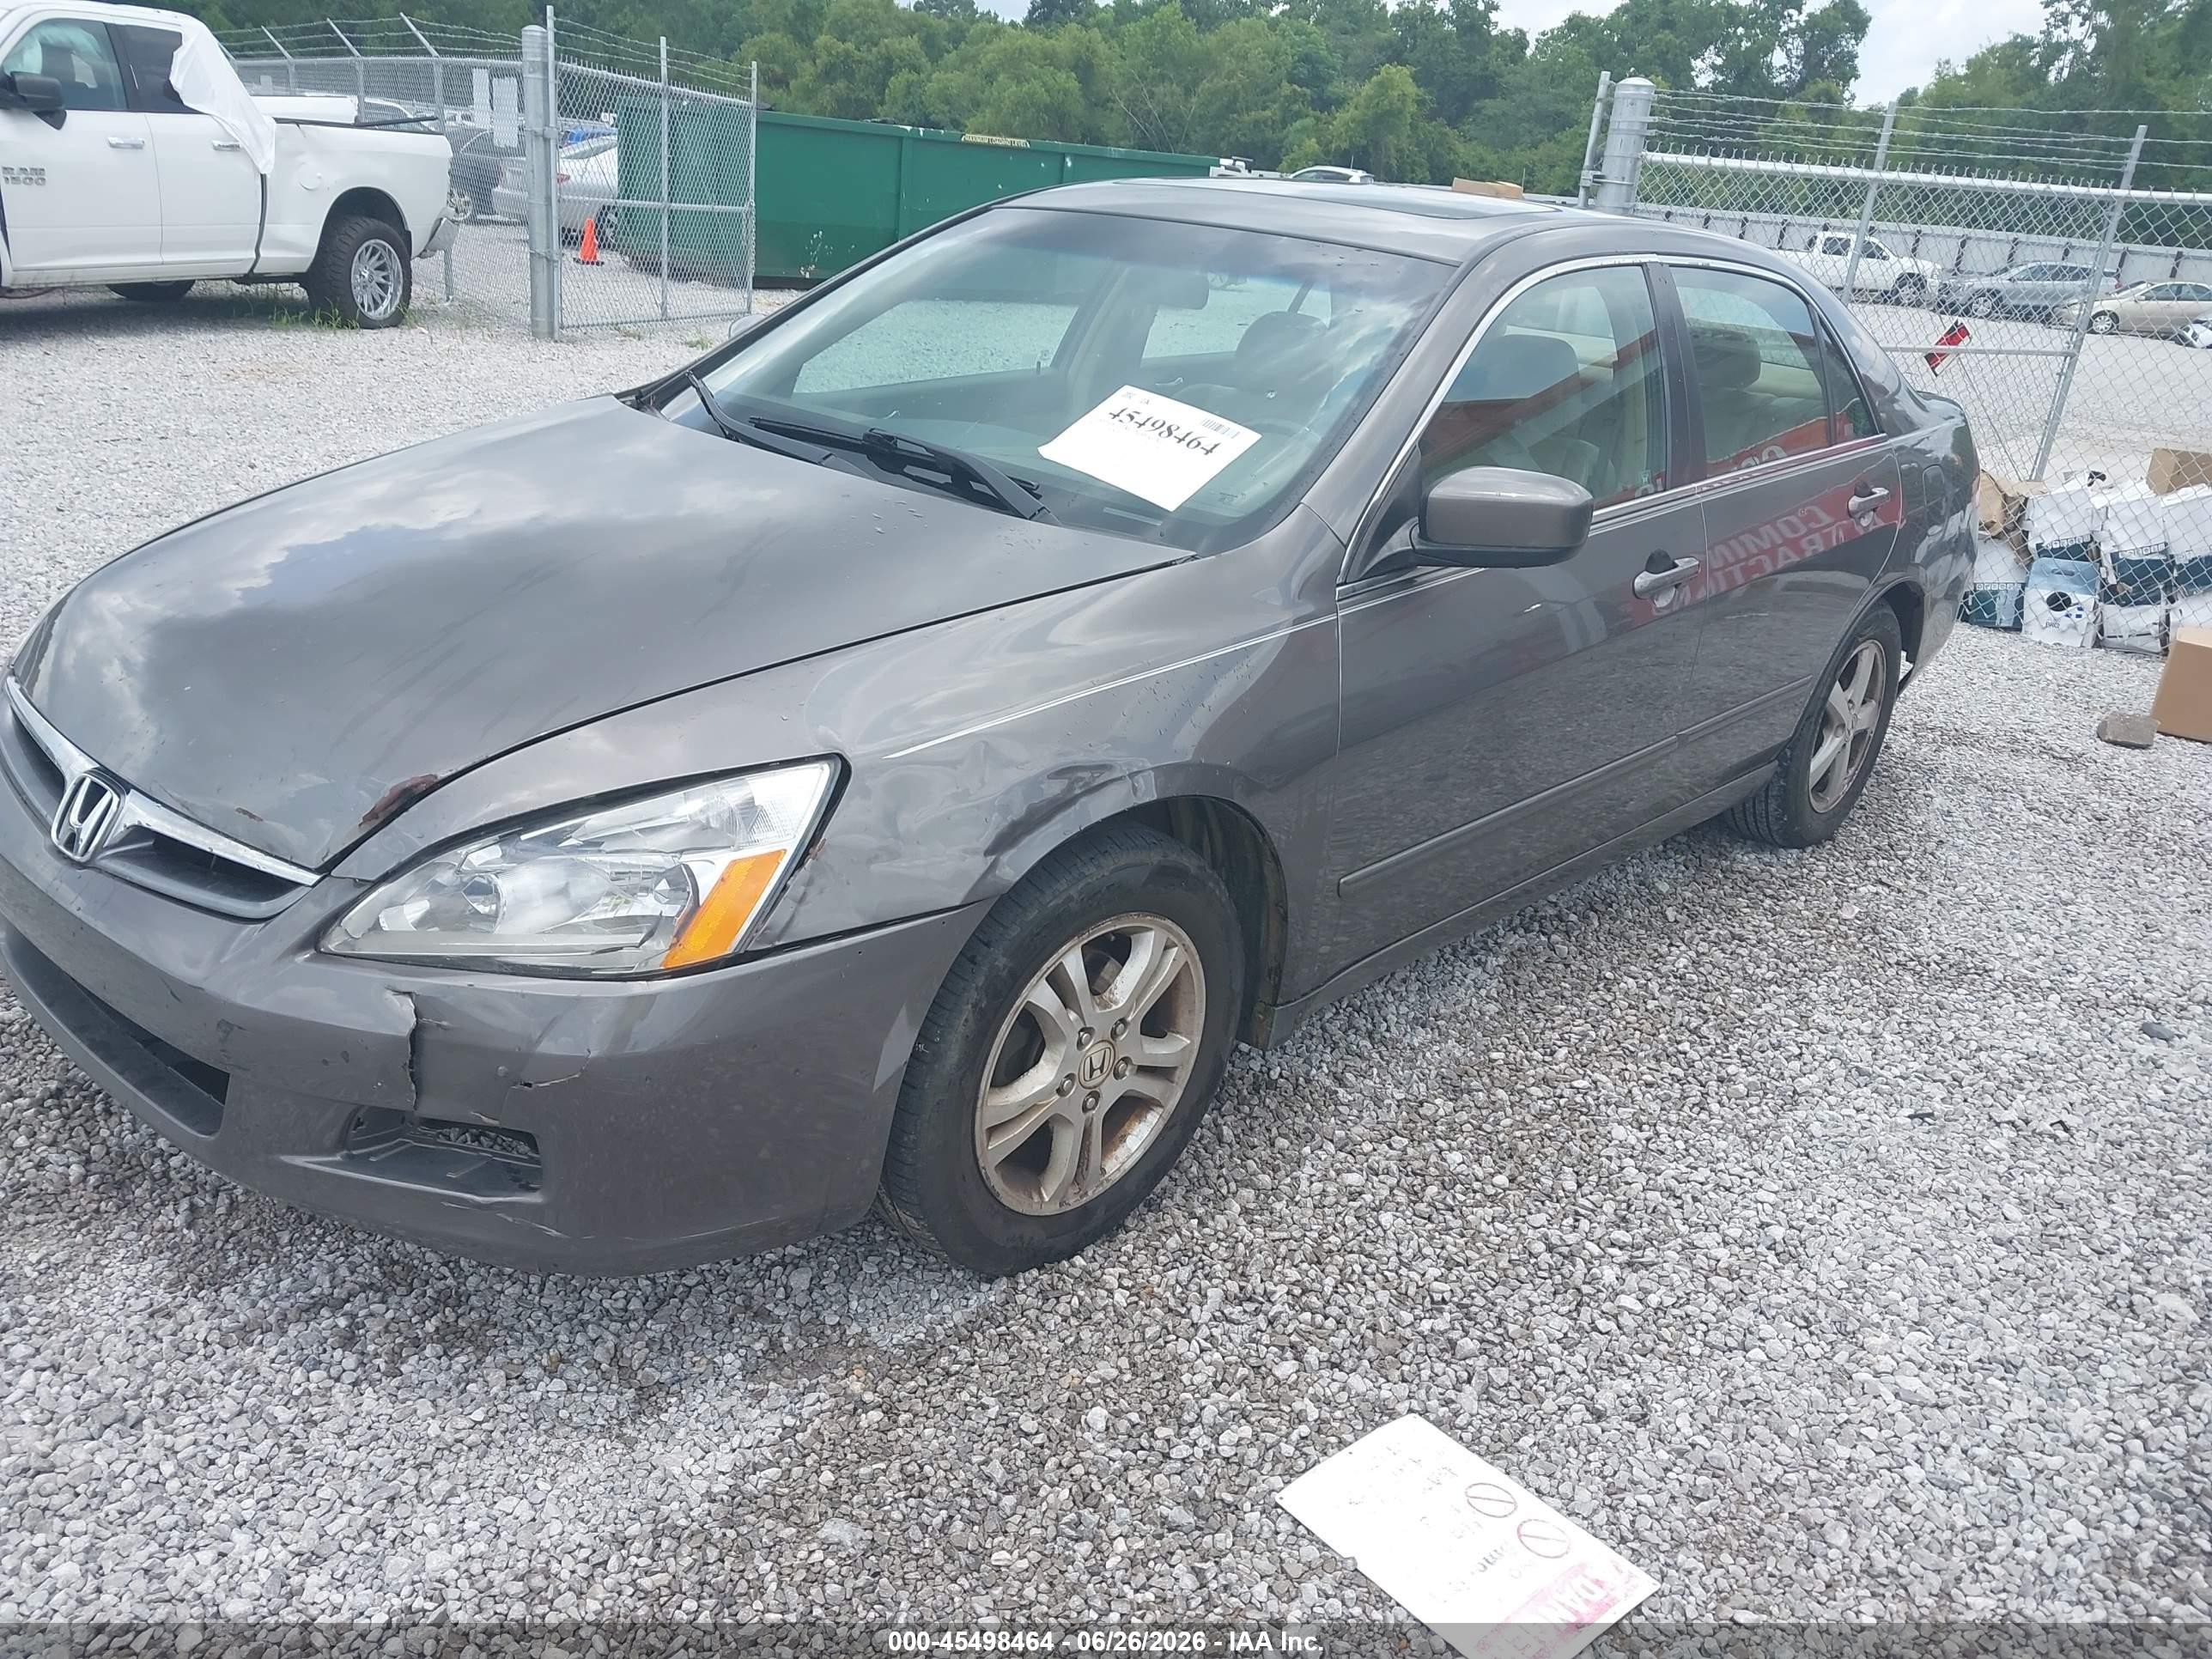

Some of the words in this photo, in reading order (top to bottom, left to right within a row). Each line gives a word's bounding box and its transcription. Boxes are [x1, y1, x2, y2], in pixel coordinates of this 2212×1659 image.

[964, 135, 988, 143] MAXIMUM
[989, 137, 1012, 146] LOADING
[2, 167, 46, 175] RAM
[3, 176, 46, 185] 1500
[1107, 406, 1222, 457] 45498464
